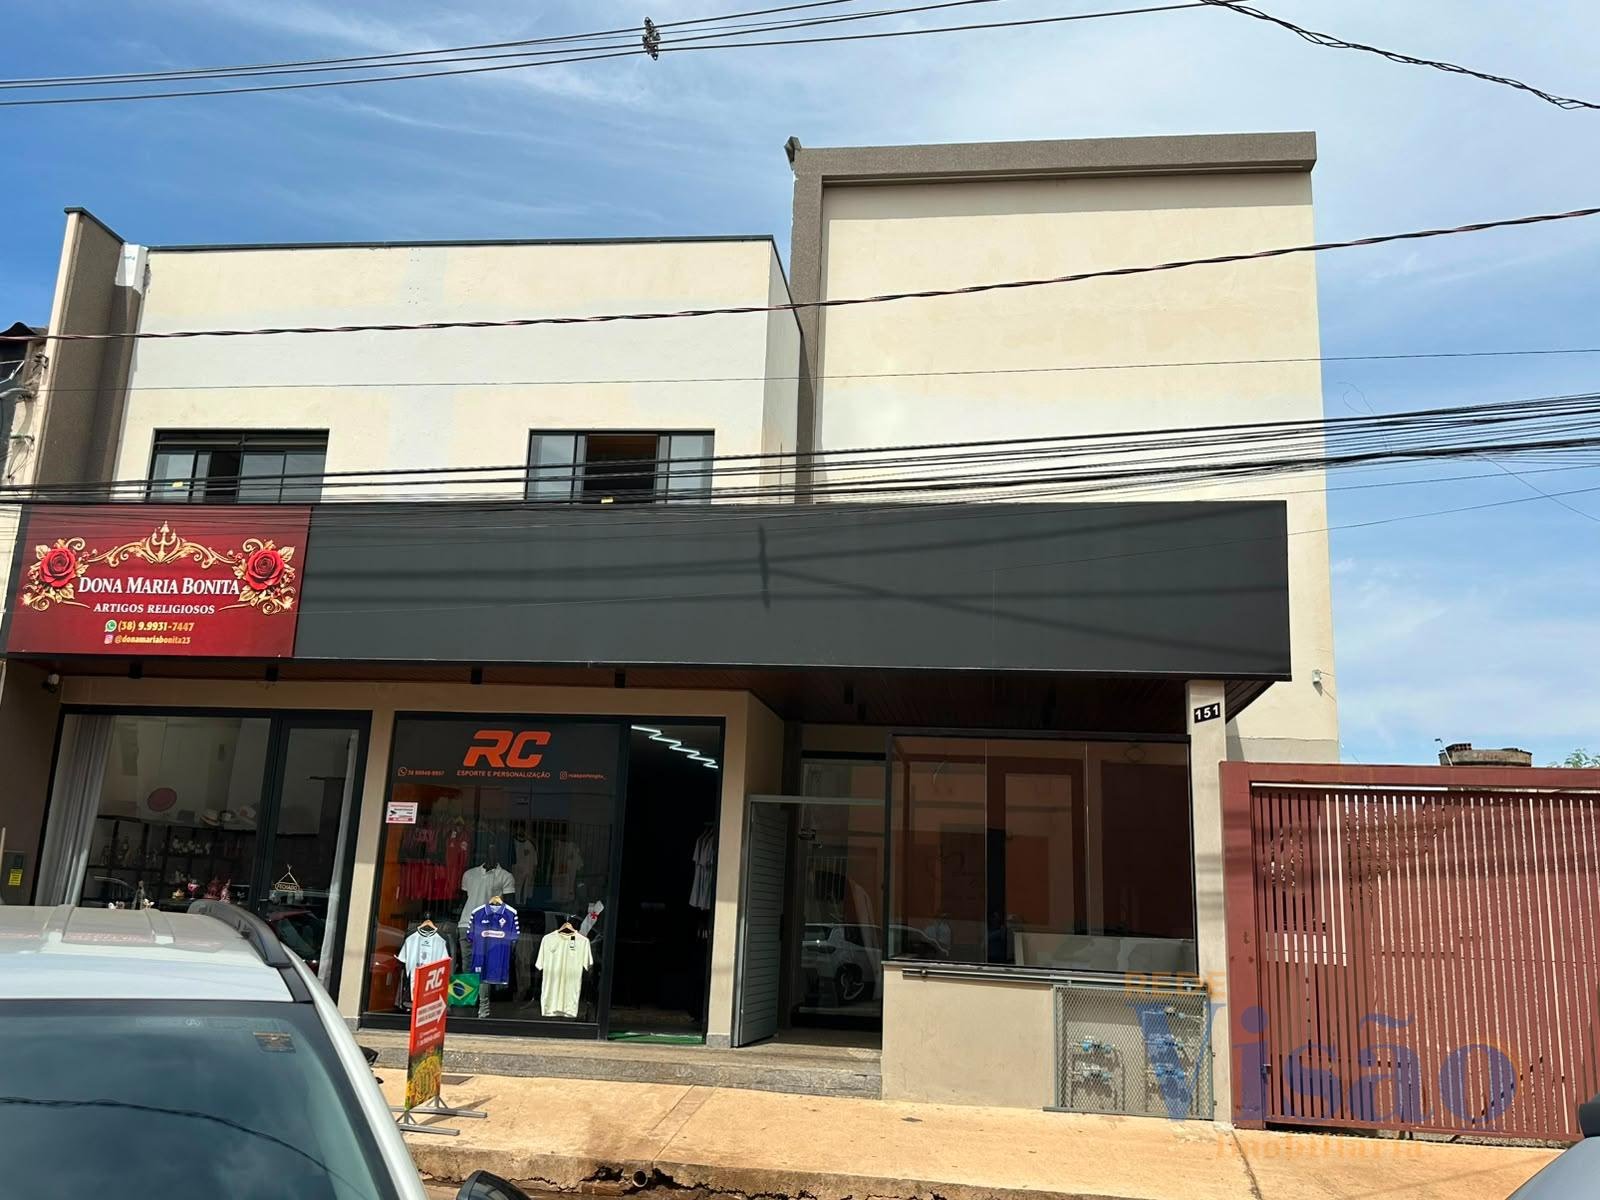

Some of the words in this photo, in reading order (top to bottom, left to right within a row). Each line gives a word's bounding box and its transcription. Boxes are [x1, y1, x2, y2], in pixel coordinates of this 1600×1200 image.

[78, 577, 123, 593] DONA
[126, 577, 178, 594] MARIA
[181, 577, 240, 595] BONITA
[93, 603, 144, 613] ARTIGOS
[147, 604, 215, 614] RELIGIOSOS
[118, 620, 136, 632] (38)
[1195, 704, 1218, 720] 151
[463, 730, 551, 768] RC
[456, 769, 486, 777] ESPORTE
[493, 770, 551, 779] PERSONALIZAÇÃO
[425, 966, 445, 992] RC
